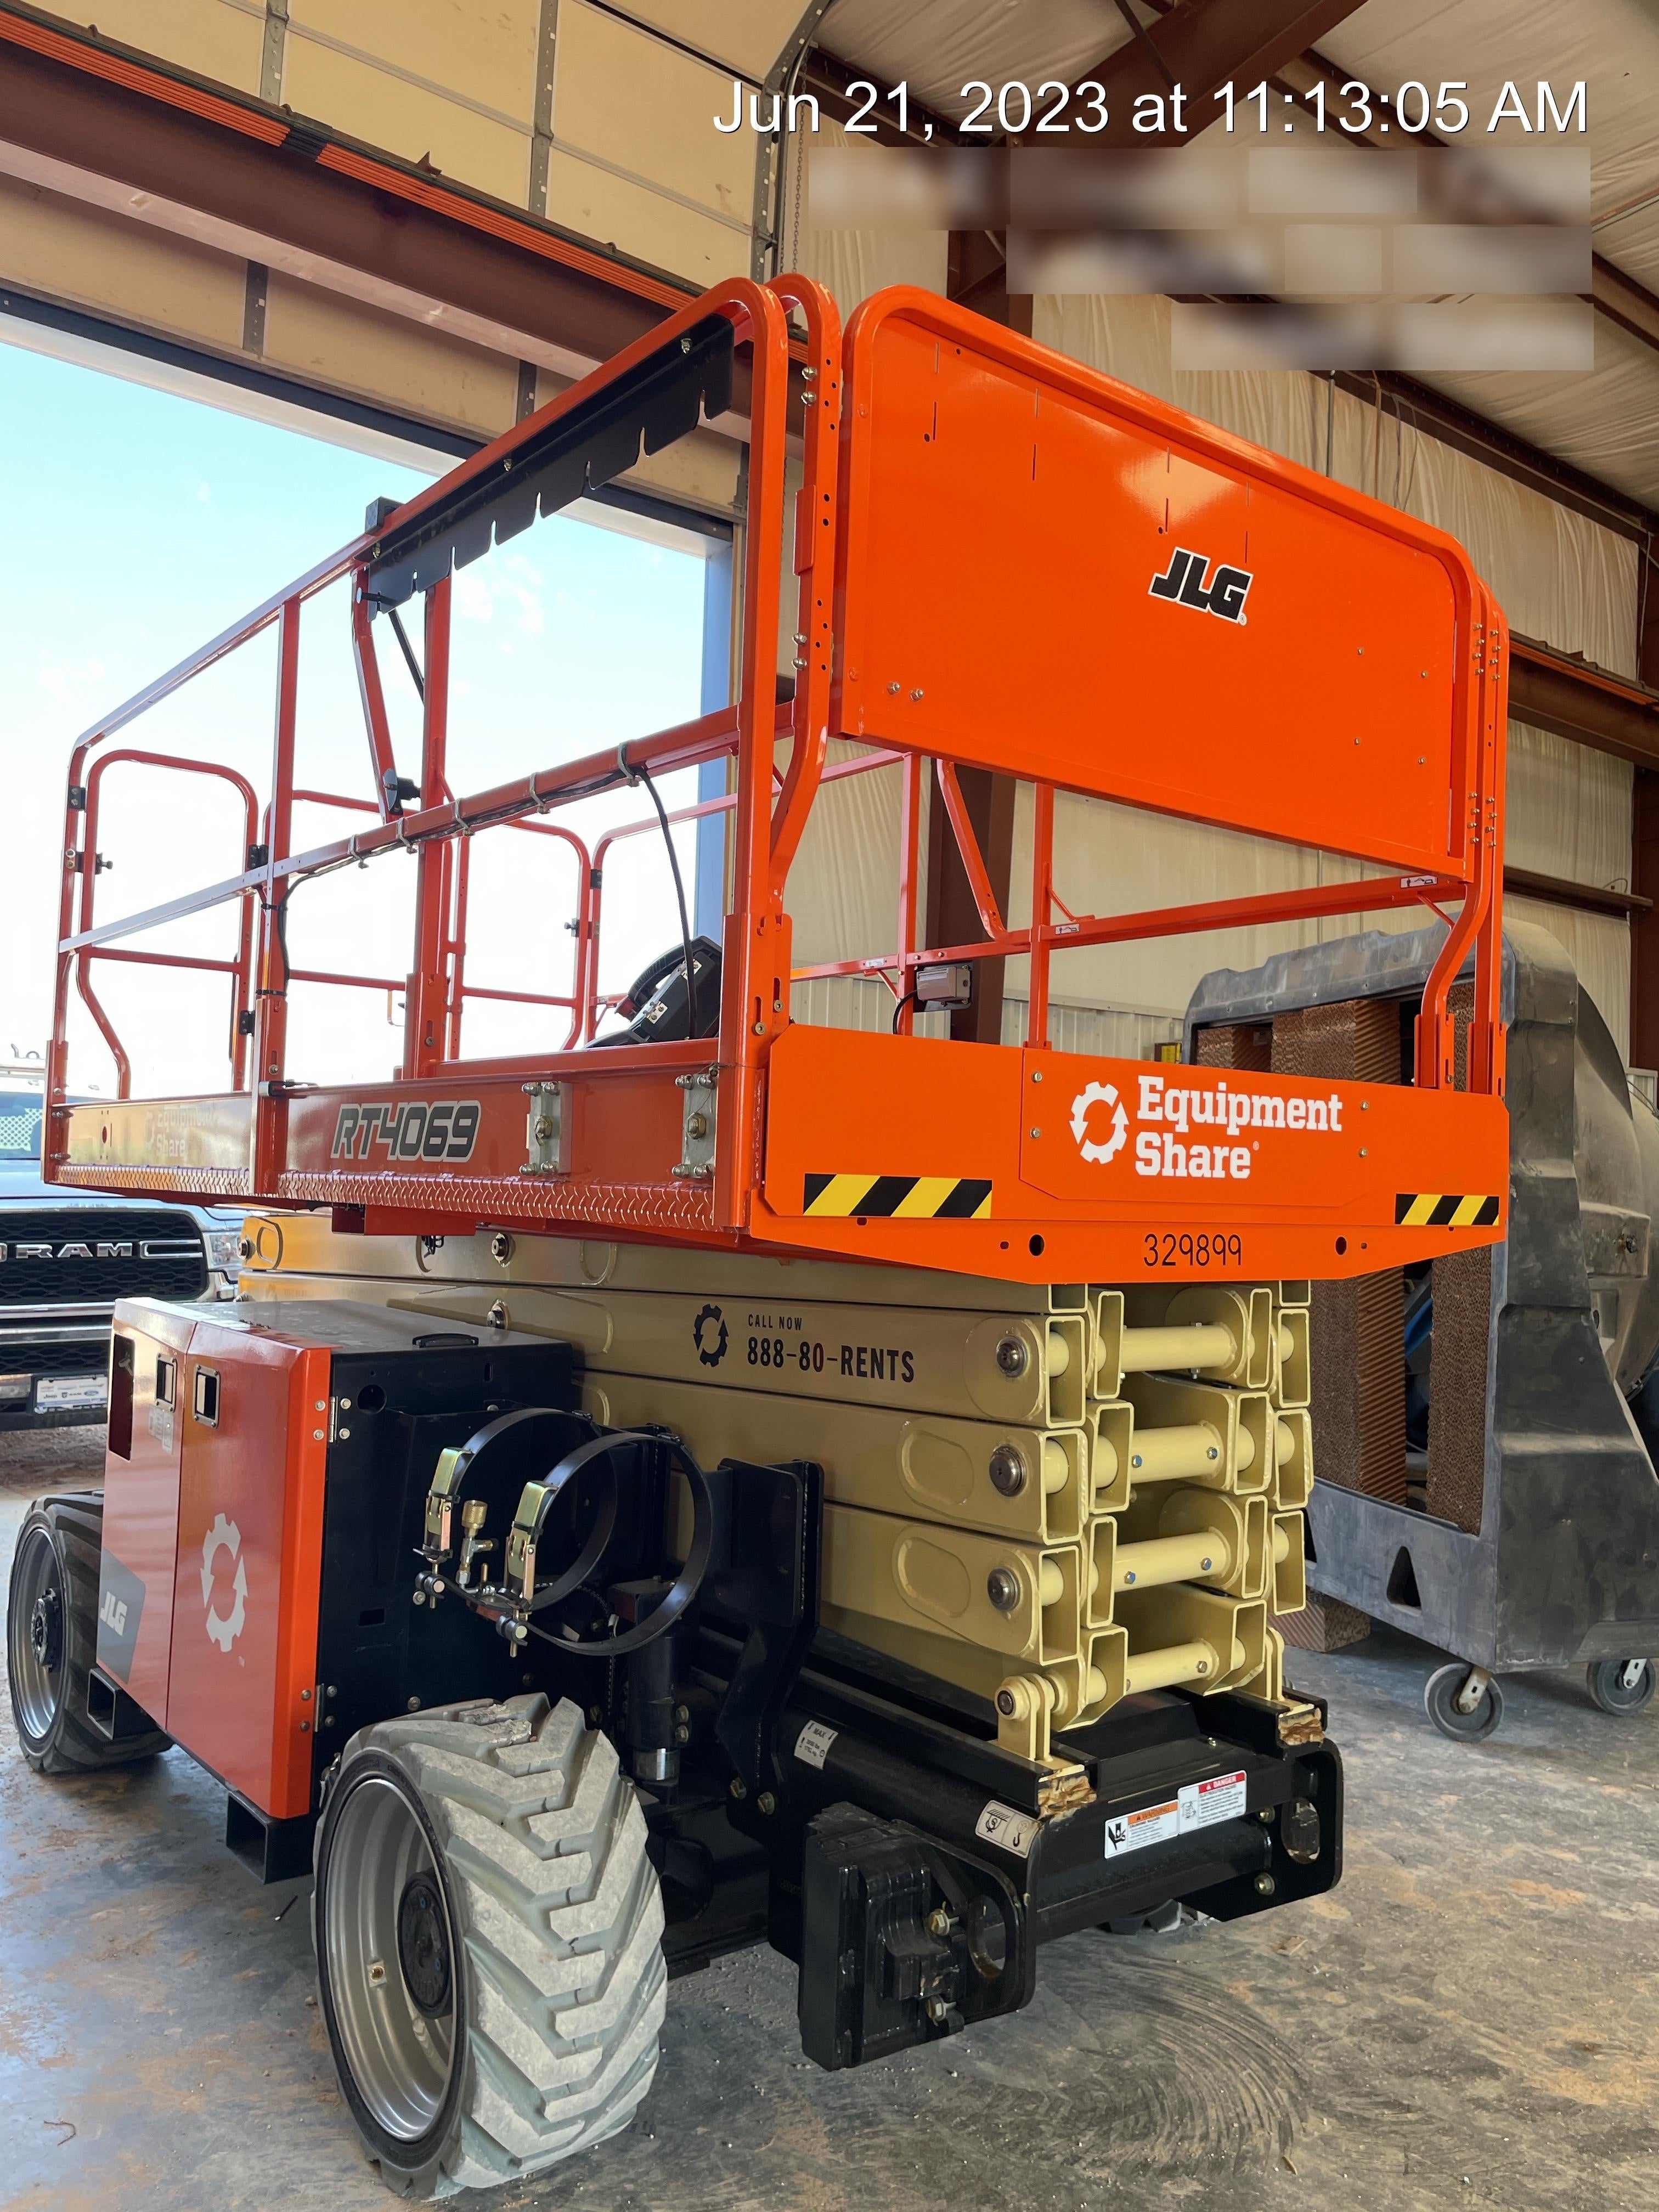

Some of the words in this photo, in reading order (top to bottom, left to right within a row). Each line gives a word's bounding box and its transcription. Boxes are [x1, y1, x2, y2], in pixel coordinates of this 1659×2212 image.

[1150, 549, 1252, 622] JLG
[1137, 1075, 1343, 1136] Equipment
[332, 1103, 480, 1160] RT4069
[15, 1243, 133, 1259] RAM
[1144, 1233, 1241, 1266] 329899
[748, 1314, 773, 1329] CALL
[779, 1316, 802, 1331] NOW
[747, 1336, 915, 1383] 888-80-RENTS
[100, 1590, 128, 1636] JLG
[1213, 1775, 1237, 1788] DANGER
